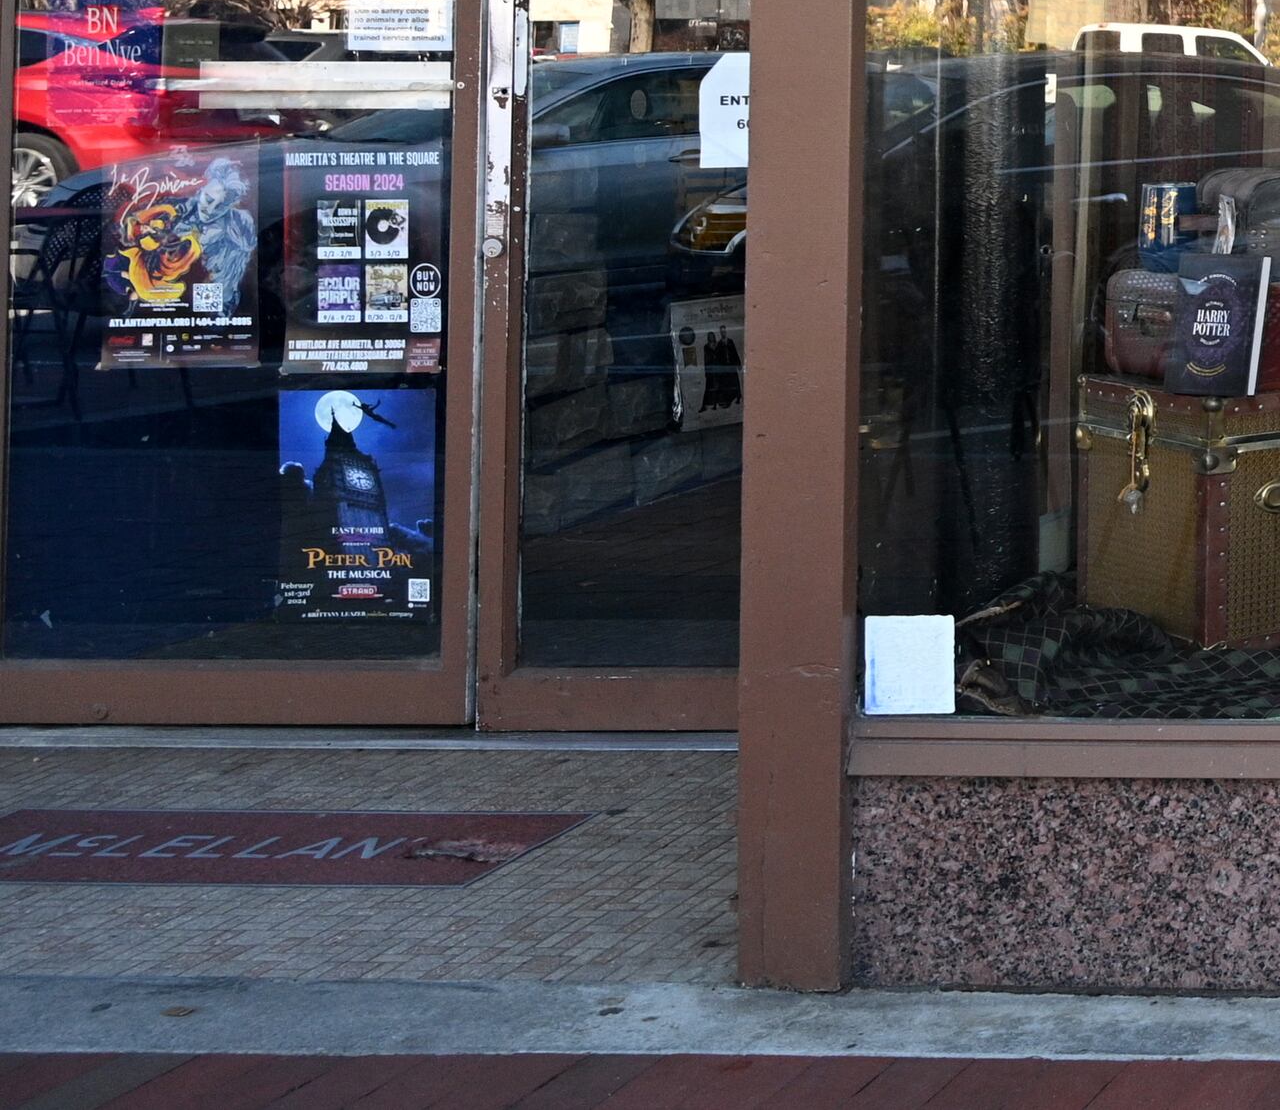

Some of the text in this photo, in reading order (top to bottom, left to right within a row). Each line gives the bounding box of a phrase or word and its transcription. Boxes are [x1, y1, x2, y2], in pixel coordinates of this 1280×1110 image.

[86, 6, 119, 34] BN
[64, 39, 100, 67] Ben
[285, 151, 440, 166] MARIETTA'S THEATRE IN THE SQUARE
[325, 173, 405, 191] SEASON 2024
[416, 270, 435, 281] BUY
[324, 276, 361, 290] COLOR
[416, 281, 435, 292] NOW
[318, 290, 361, 305] PURPLE
[1196, 309, 1231, 323] HARRY
[1192, 322, 1231, 337] POTTER
[328, 340, 340, 350] AVE
[331, 526, 356, 535] EAST
[327, 570, 392, 579] THE MUSICAL
[280, 582, 314, 590] February
[287, 597, 307, 605] 2024
